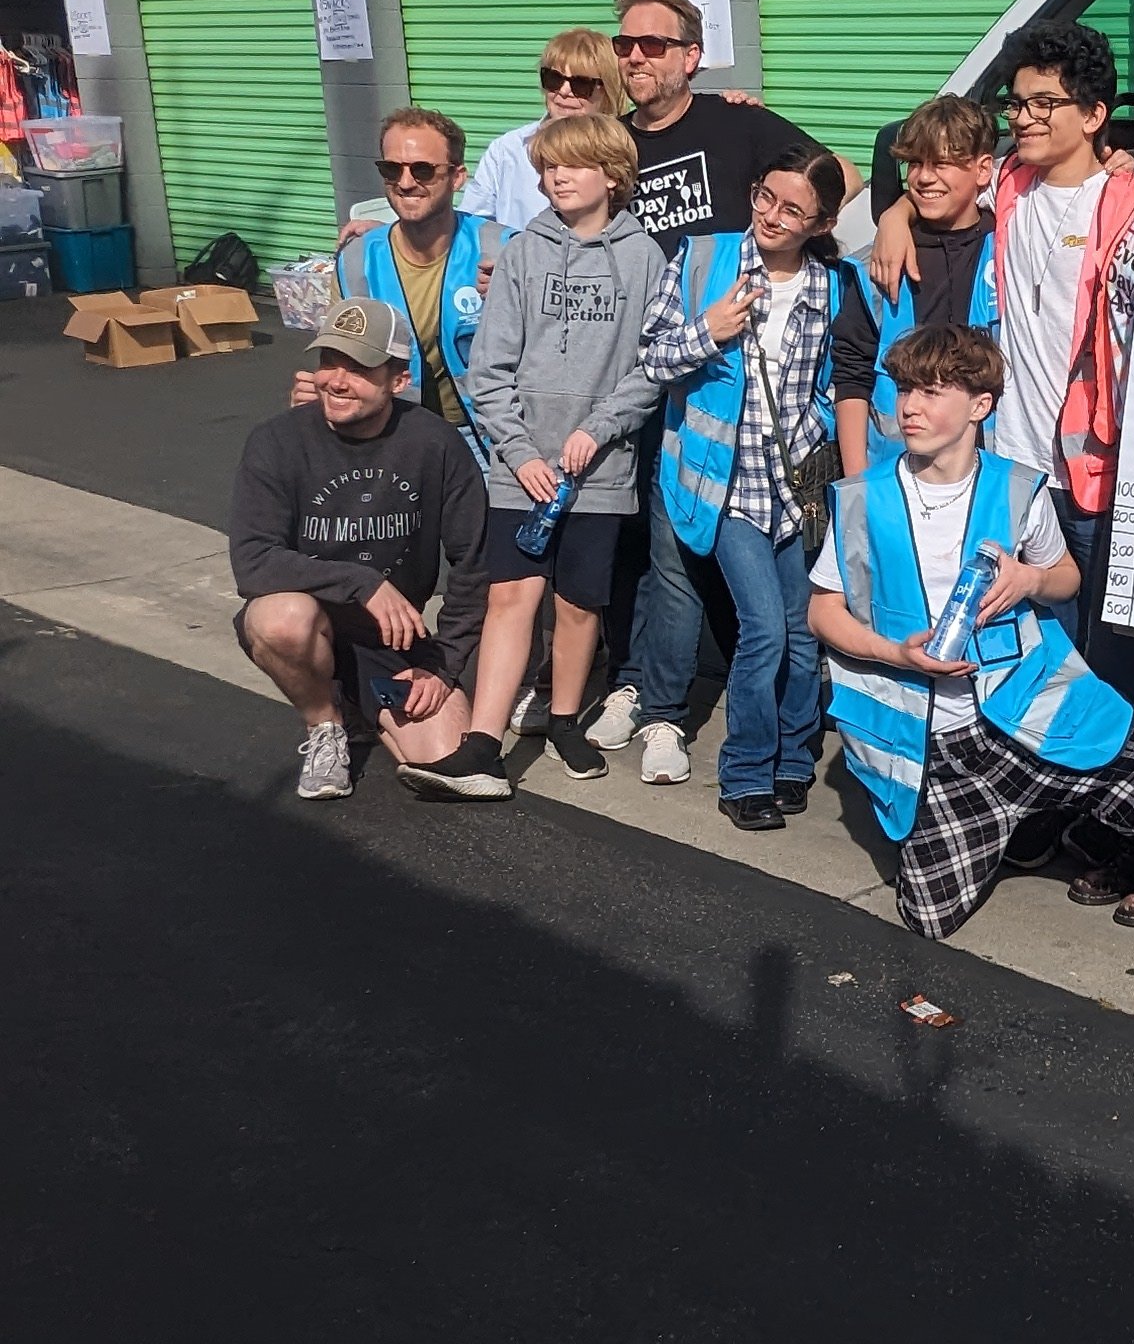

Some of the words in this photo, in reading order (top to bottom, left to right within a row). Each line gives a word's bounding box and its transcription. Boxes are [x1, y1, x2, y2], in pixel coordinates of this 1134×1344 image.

[630, 195, 669, 217] Day
[643, 203, 714, 235] Action
[551, 279, 602, 296] Every
[312, 468, 384, 506] WITHOUT
[391, 473, 419, 502] YOU
[303, 516, 331, 542] JON
[1111, 541, 1134, 558] 300
[1109, 573, 1129, 587] 400
[1106, 601, 1130, 616] 500
